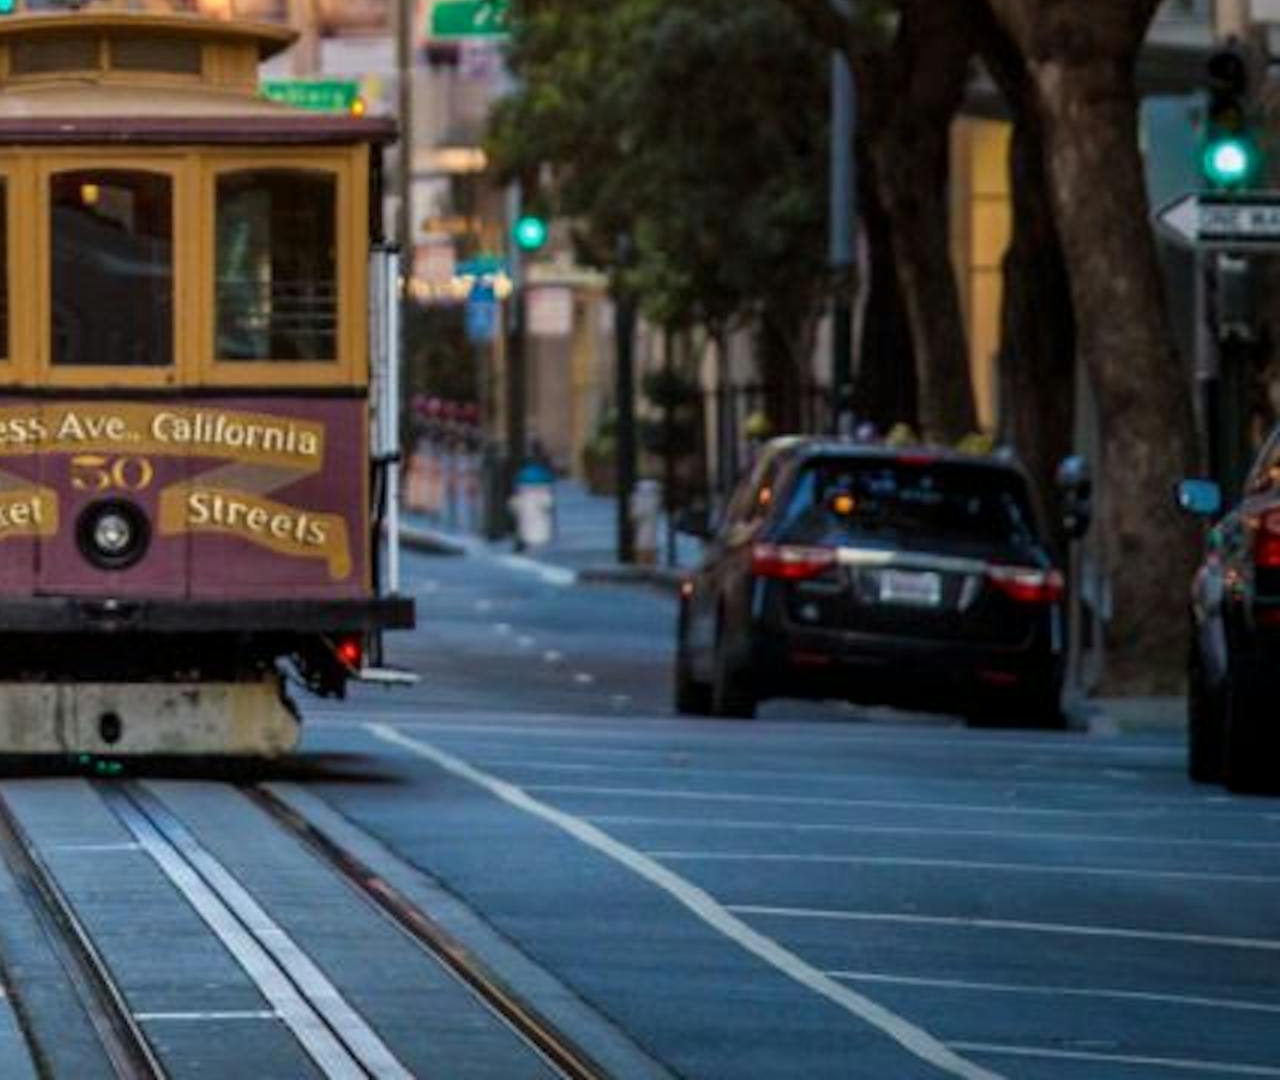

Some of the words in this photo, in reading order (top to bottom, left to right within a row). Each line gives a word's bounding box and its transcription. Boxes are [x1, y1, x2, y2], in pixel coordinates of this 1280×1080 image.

[152, 412, 318, 456] California
[70, 454, 153, 492] 50
[188, 491, 327, 545] Streets
